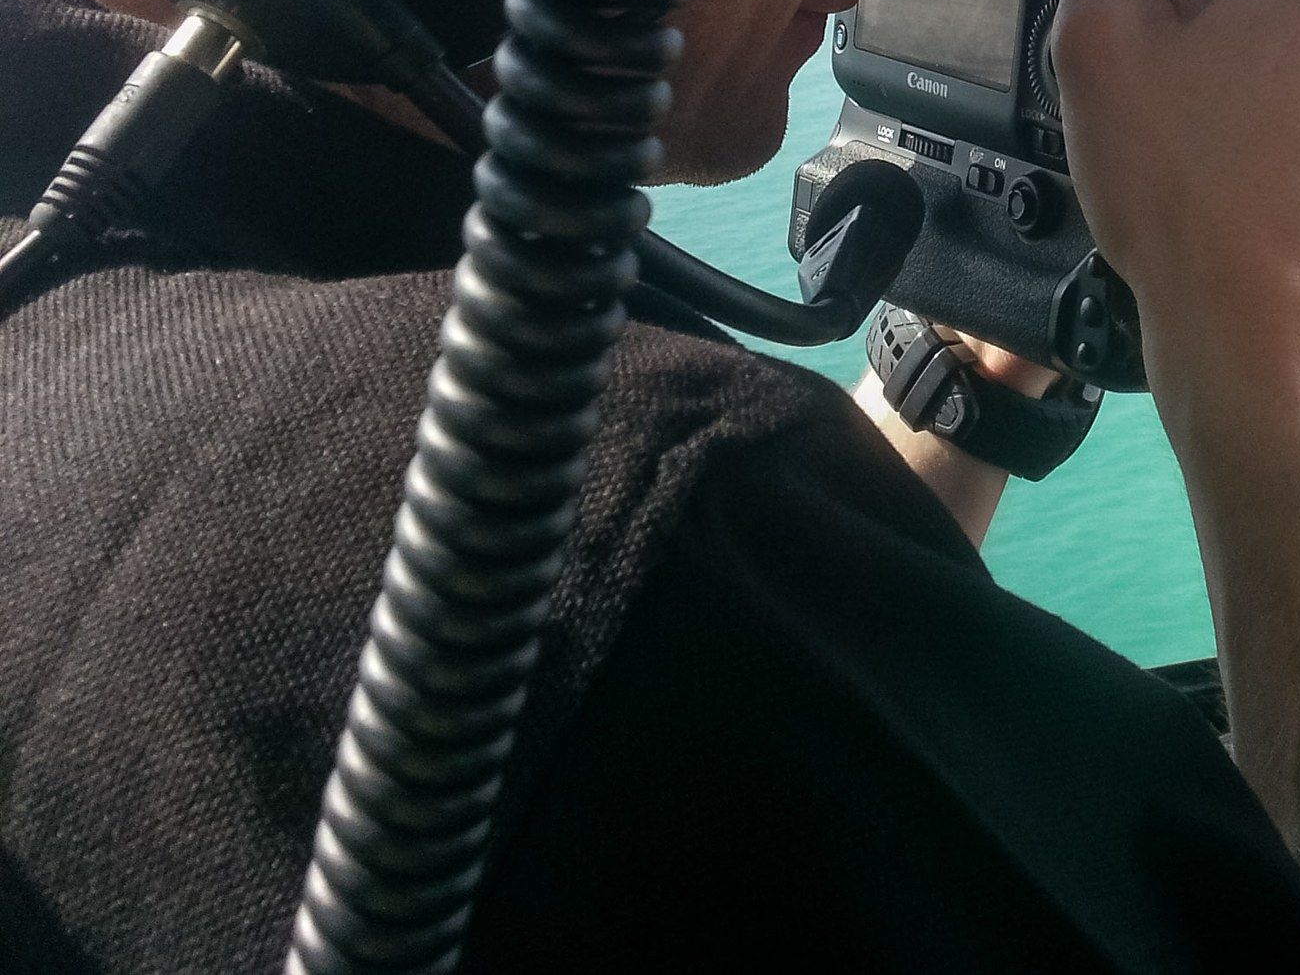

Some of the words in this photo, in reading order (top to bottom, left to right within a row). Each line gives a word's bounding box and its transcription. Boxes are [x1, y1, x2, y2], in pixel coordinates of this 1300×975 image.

[907, 71, 949, 98] Canon
[877, 125, 895, 139] LOCK
[994, 157, 1007, 170] ON
